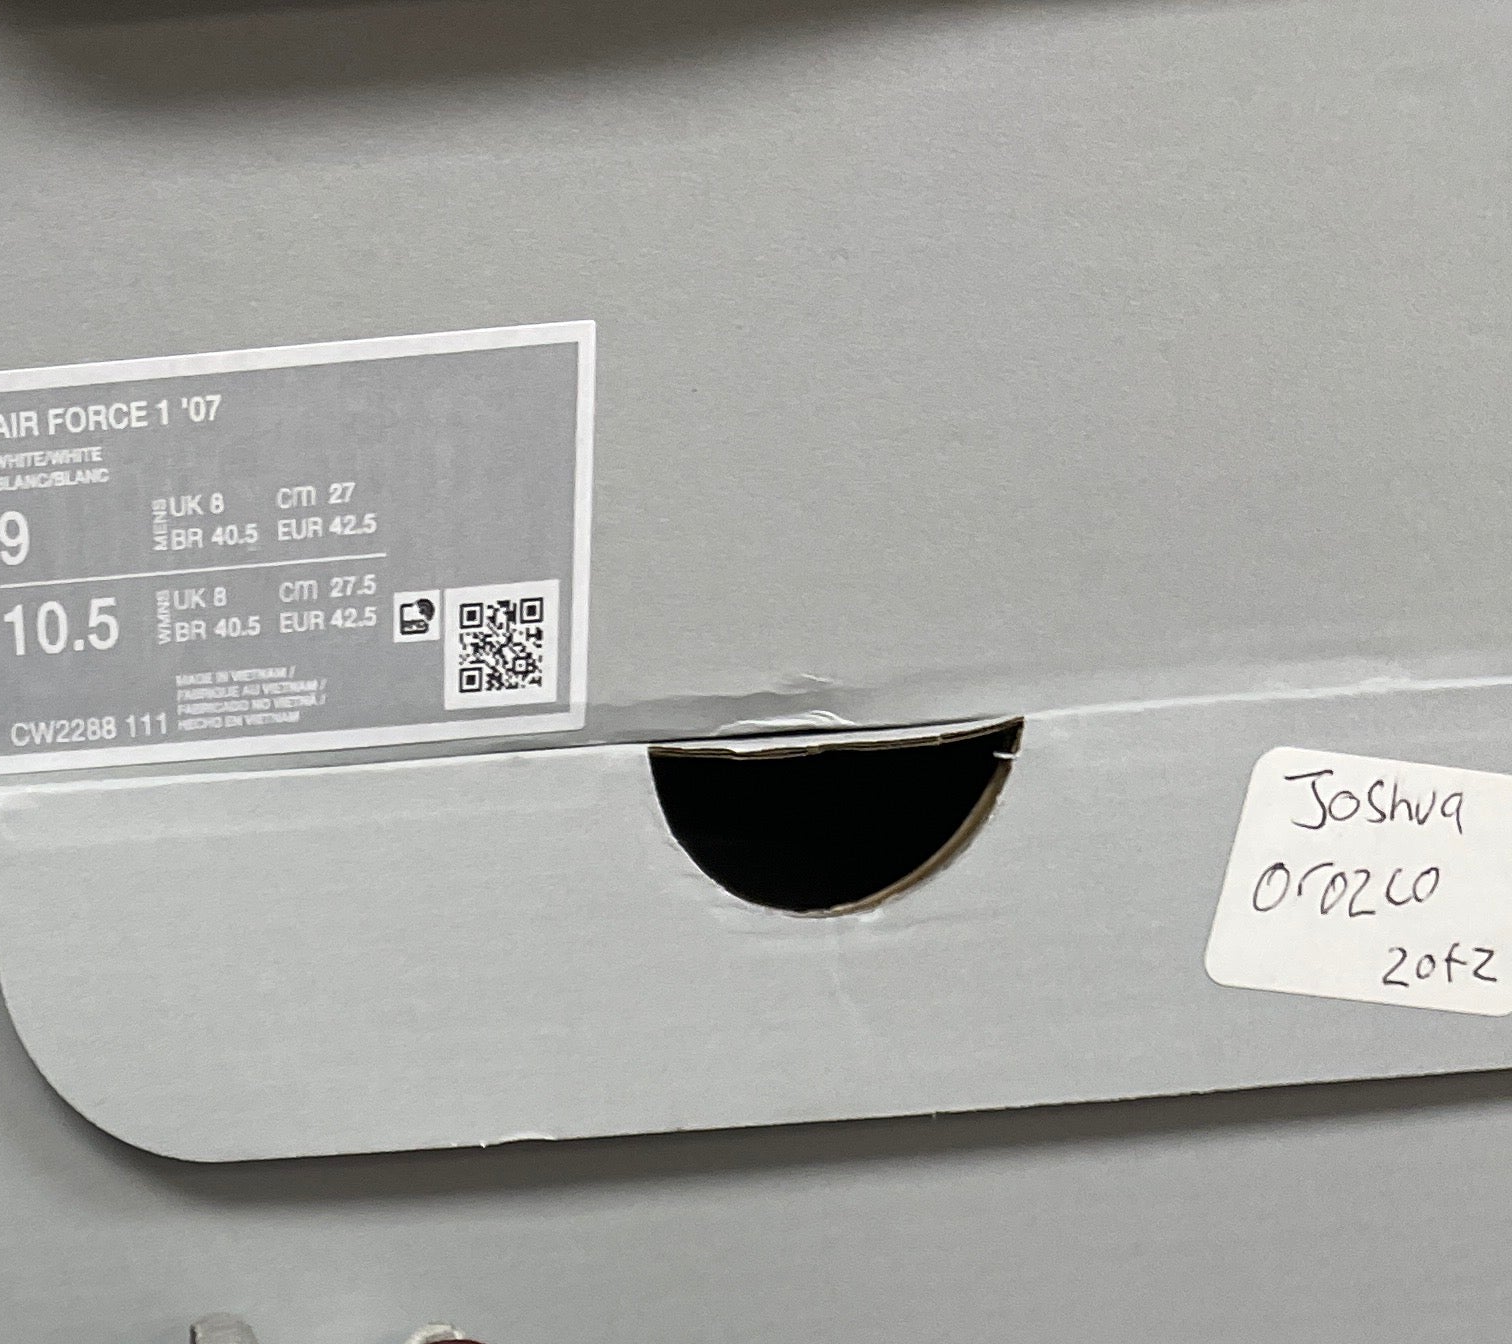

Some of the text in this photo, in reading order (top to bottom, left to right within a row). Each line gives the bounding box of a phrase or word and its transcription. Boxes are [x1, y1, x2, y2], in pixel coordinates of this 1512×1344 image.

[47, 400, 149, 436] FORCE
[155, 399, 169, 425] 1
[181, 394, 222, 422] '07
[168, 492, 225, 518] UK 8
[328, 481, 356, 505] 27
[170, 523, 258, 551] BR 40.5
[277, 513, 377, 542] EUR 42.5
[173, 586, 227, 611] UK 8
[329, 574, 377, 599] 27.5
[2, 596, 120, 657] 10.5
[175, 615, 261, 643] BR 40.5
[279, 606, 377, 634] EUR 42.5
[10, 712, 168, 747] CW2288 111
